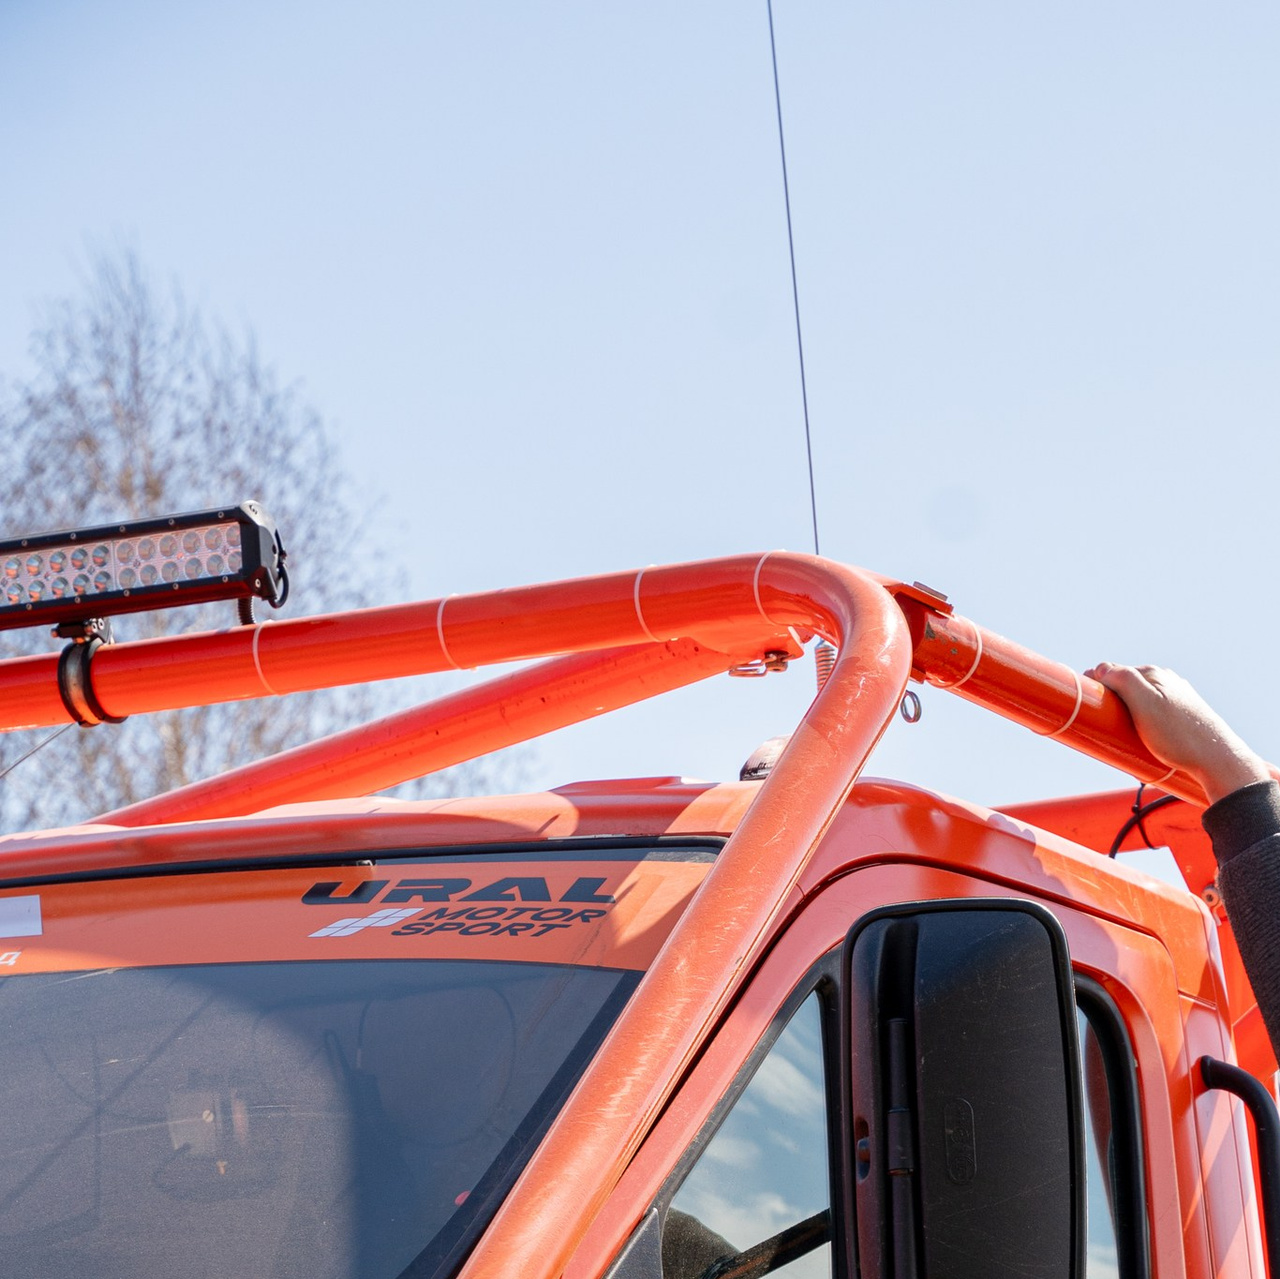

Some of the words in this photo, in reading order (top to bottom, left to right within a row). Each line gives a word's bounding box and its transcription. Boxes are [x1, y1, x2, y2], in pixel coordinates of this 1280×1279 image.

[301, 877, 616, 906] URAL
[417, 906, 608, 924] MOTOR
[390, 921, 573, 938] SPORT
